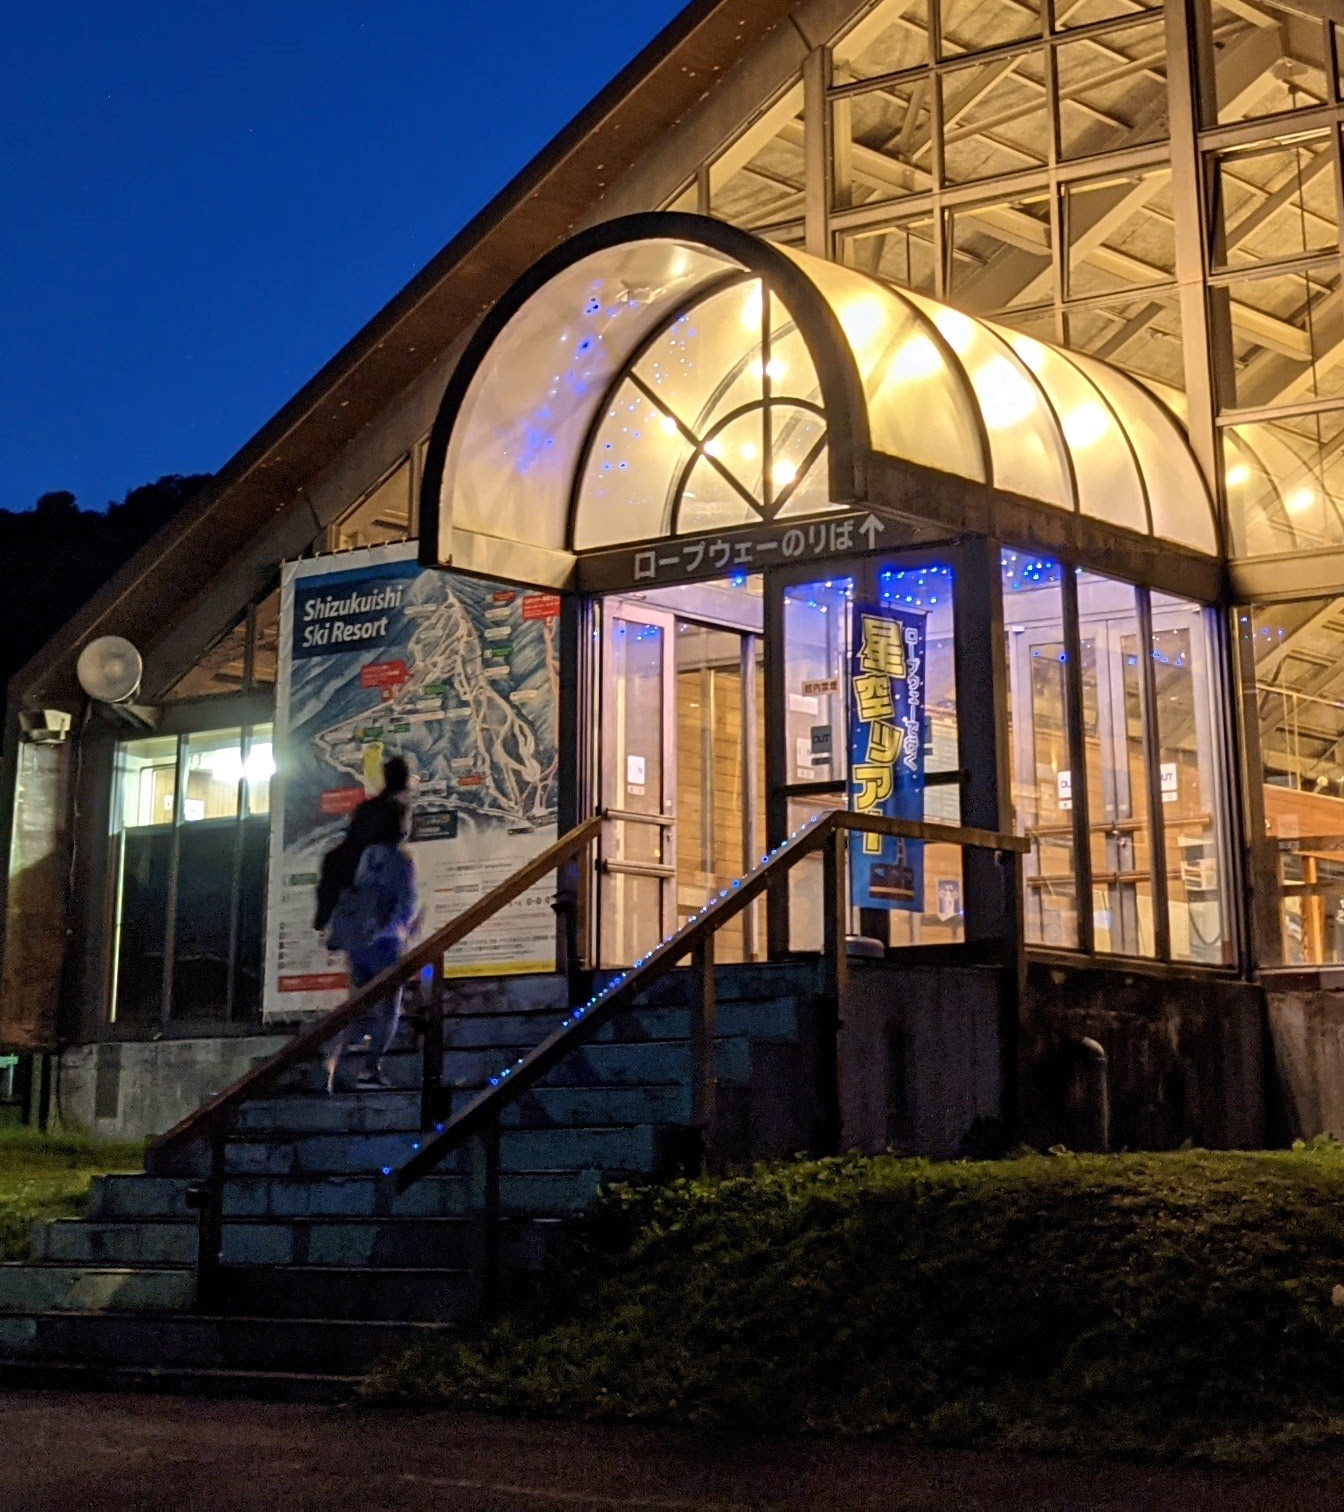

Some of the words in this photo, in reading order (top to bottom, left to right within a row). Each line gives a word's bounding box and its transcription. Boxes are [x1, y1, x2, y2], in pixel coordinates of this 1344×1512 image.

[633, 520, 856, 581] ロープウェーのりば
[303, 584, 403, 622] Shizukuishi
[302, 622, 331, 648] Ski
[331, 616, 389, 643] Resort
[813, 734, 830, 744] OUT
[852, 613, 908, 856] 星空ツアー
